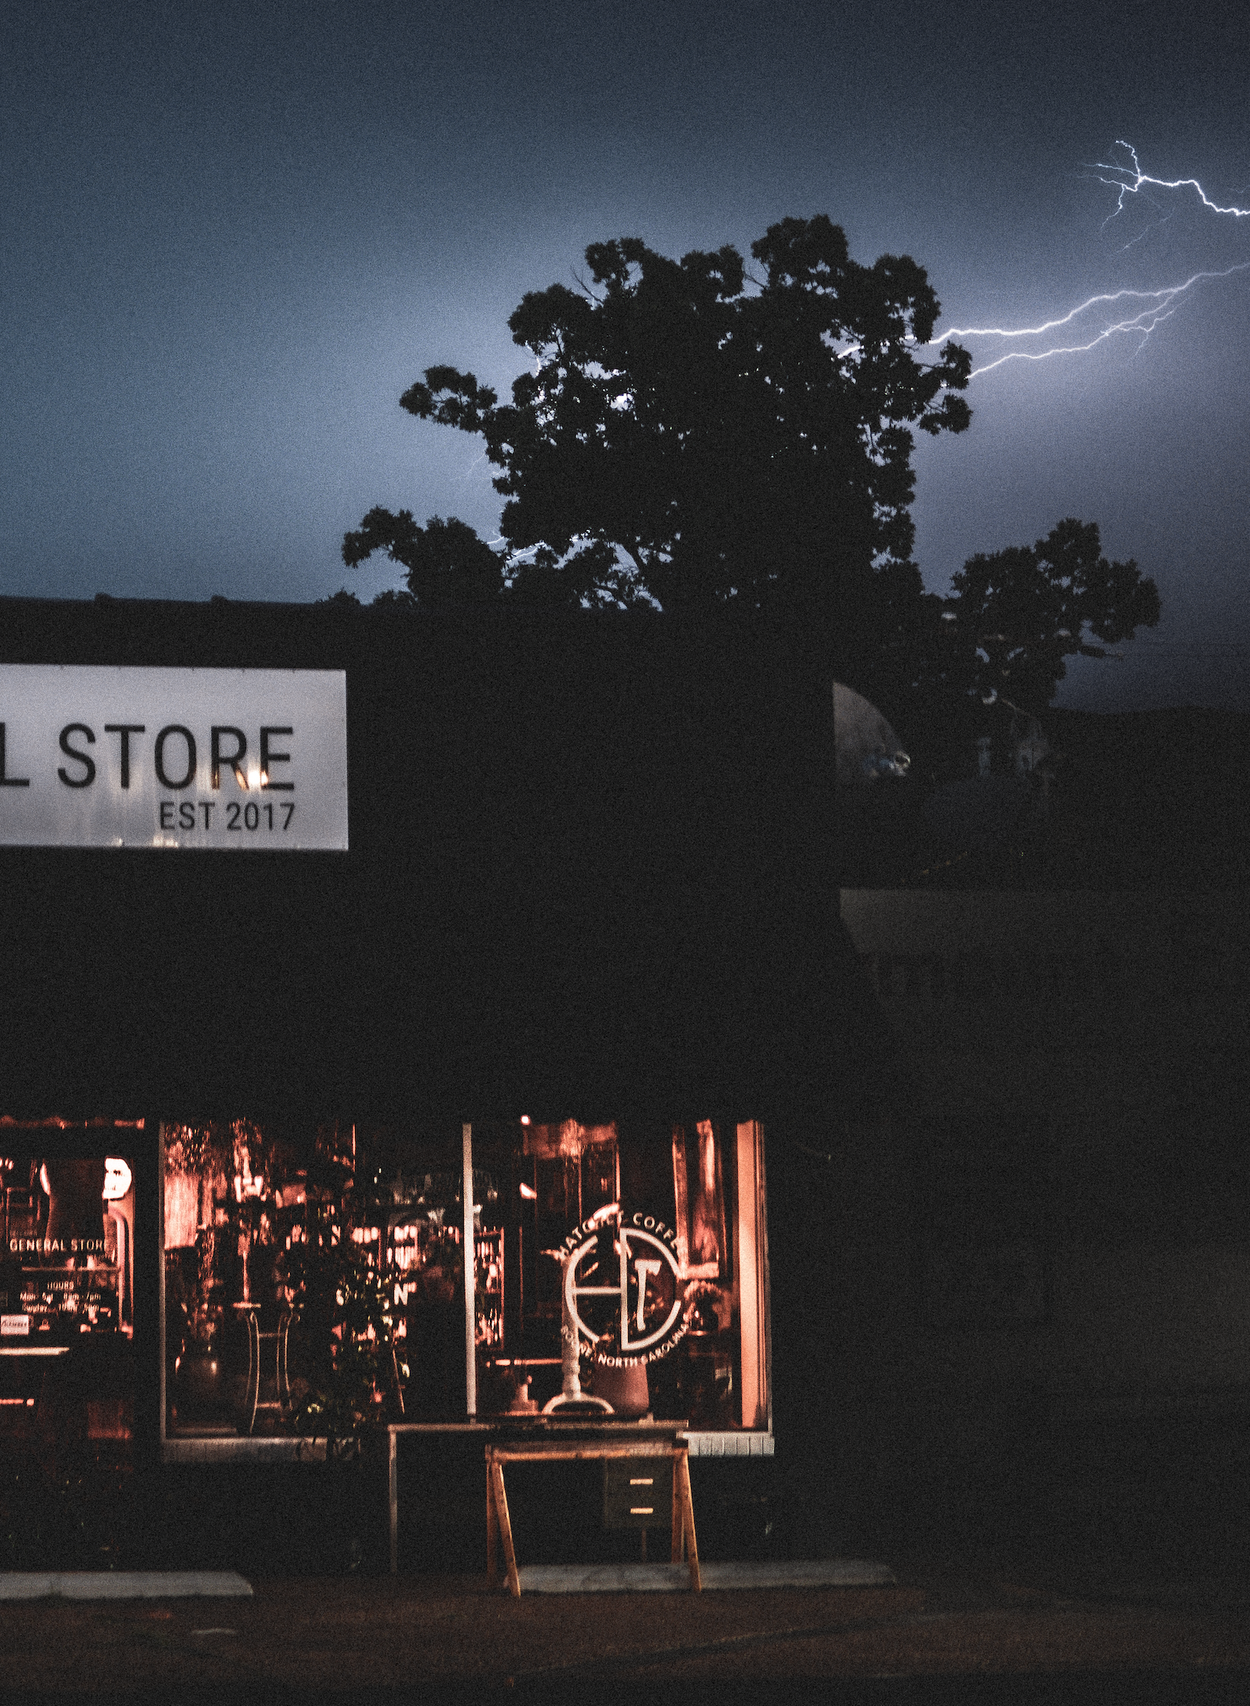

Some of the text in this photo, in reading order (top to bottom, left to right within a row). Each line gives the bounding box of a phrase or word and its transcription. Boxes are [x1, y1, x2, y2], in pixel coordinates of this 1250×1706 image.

[57, 722, 295, 791] STORE
[159, 801, 295, 831] EST 2017
[9, 1237, 67, 1253] GENERAL
[597, 1353, 638, 1369] NORTH
